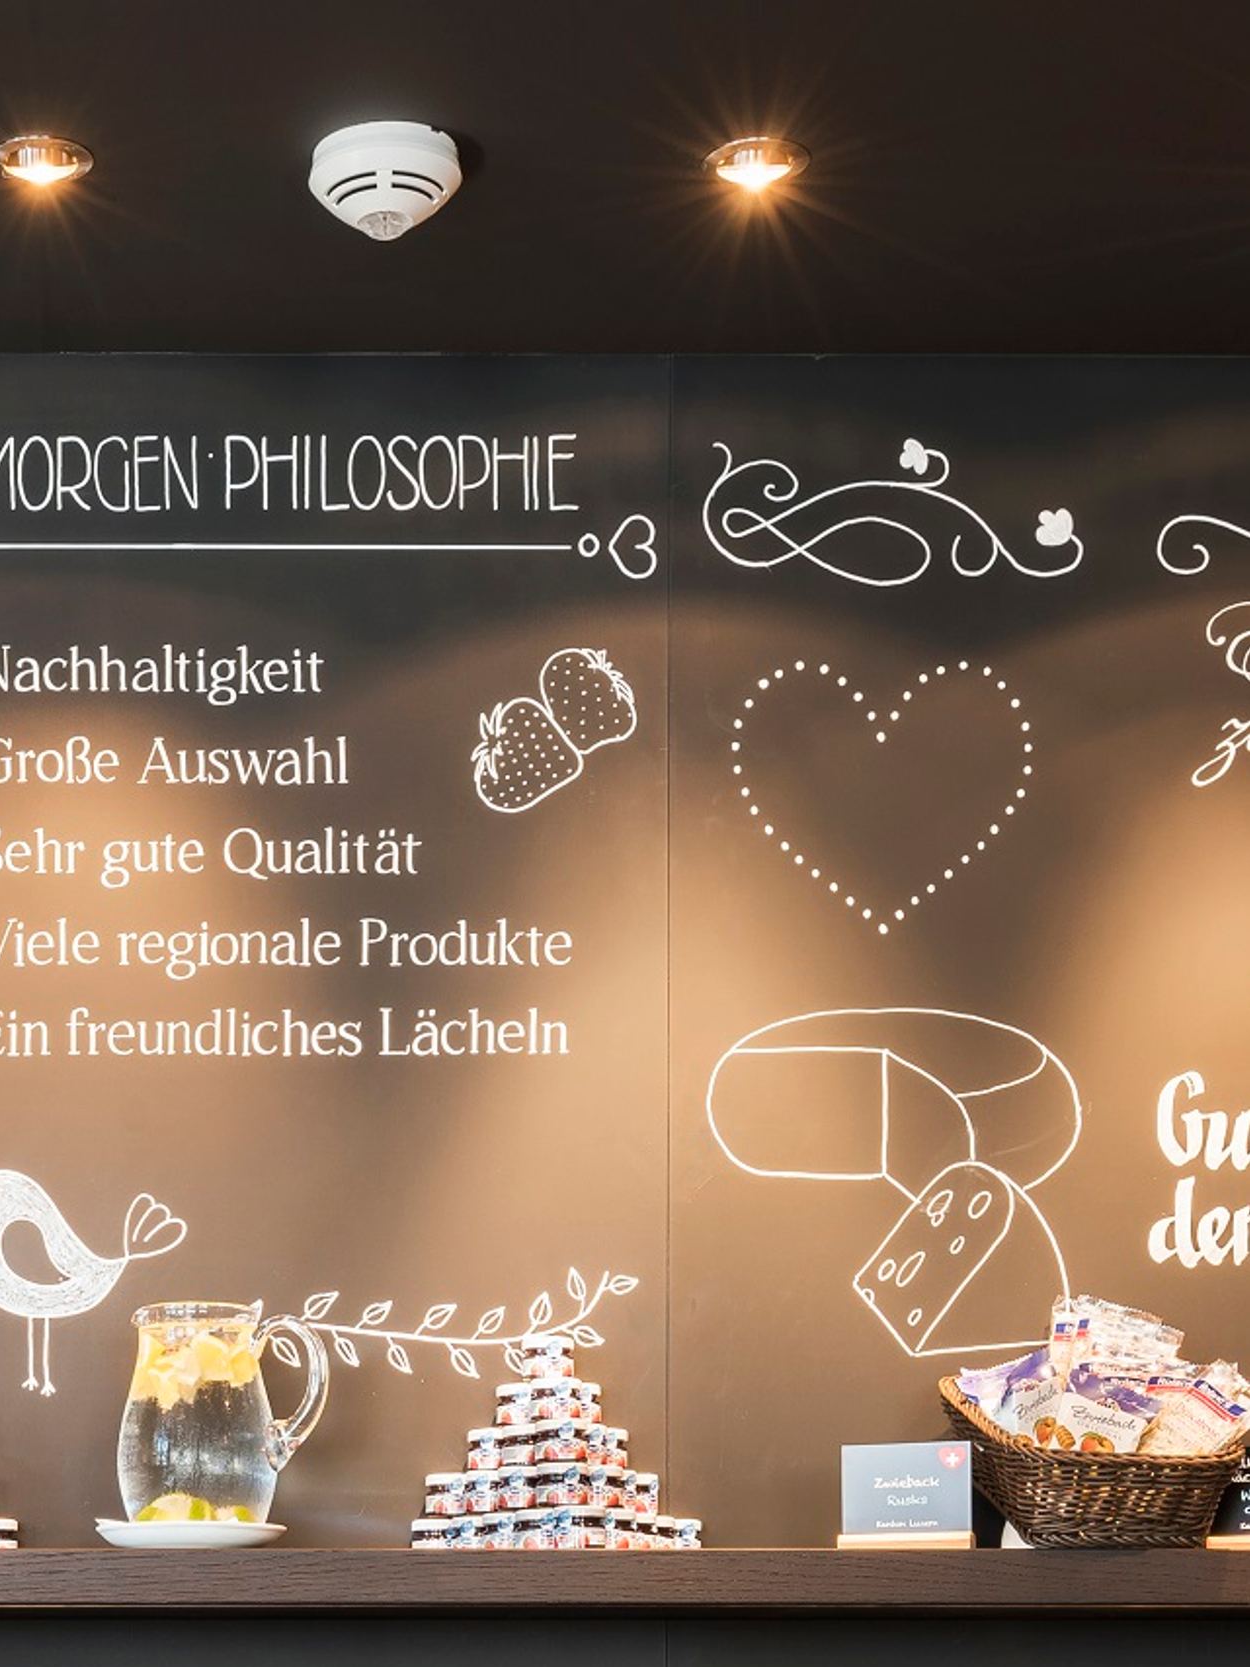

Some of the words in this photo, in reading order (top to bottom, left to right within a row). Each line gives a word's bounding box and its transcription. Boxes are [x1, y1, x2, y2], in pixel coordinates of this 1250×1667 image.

[137, 736, 350, 787] Auswahl
[99, 835, 206, 889] gute
[221, 825, 423, 882] Qualität
[116, 919, 342, 980] regionale
[357, 916, 575, 968] Produkte
[64, 1006, 364, 1059] freundliches
[378, 1005, 570, 1057] Lächeln
[874, 1475, 940, 1490] Zwieback
